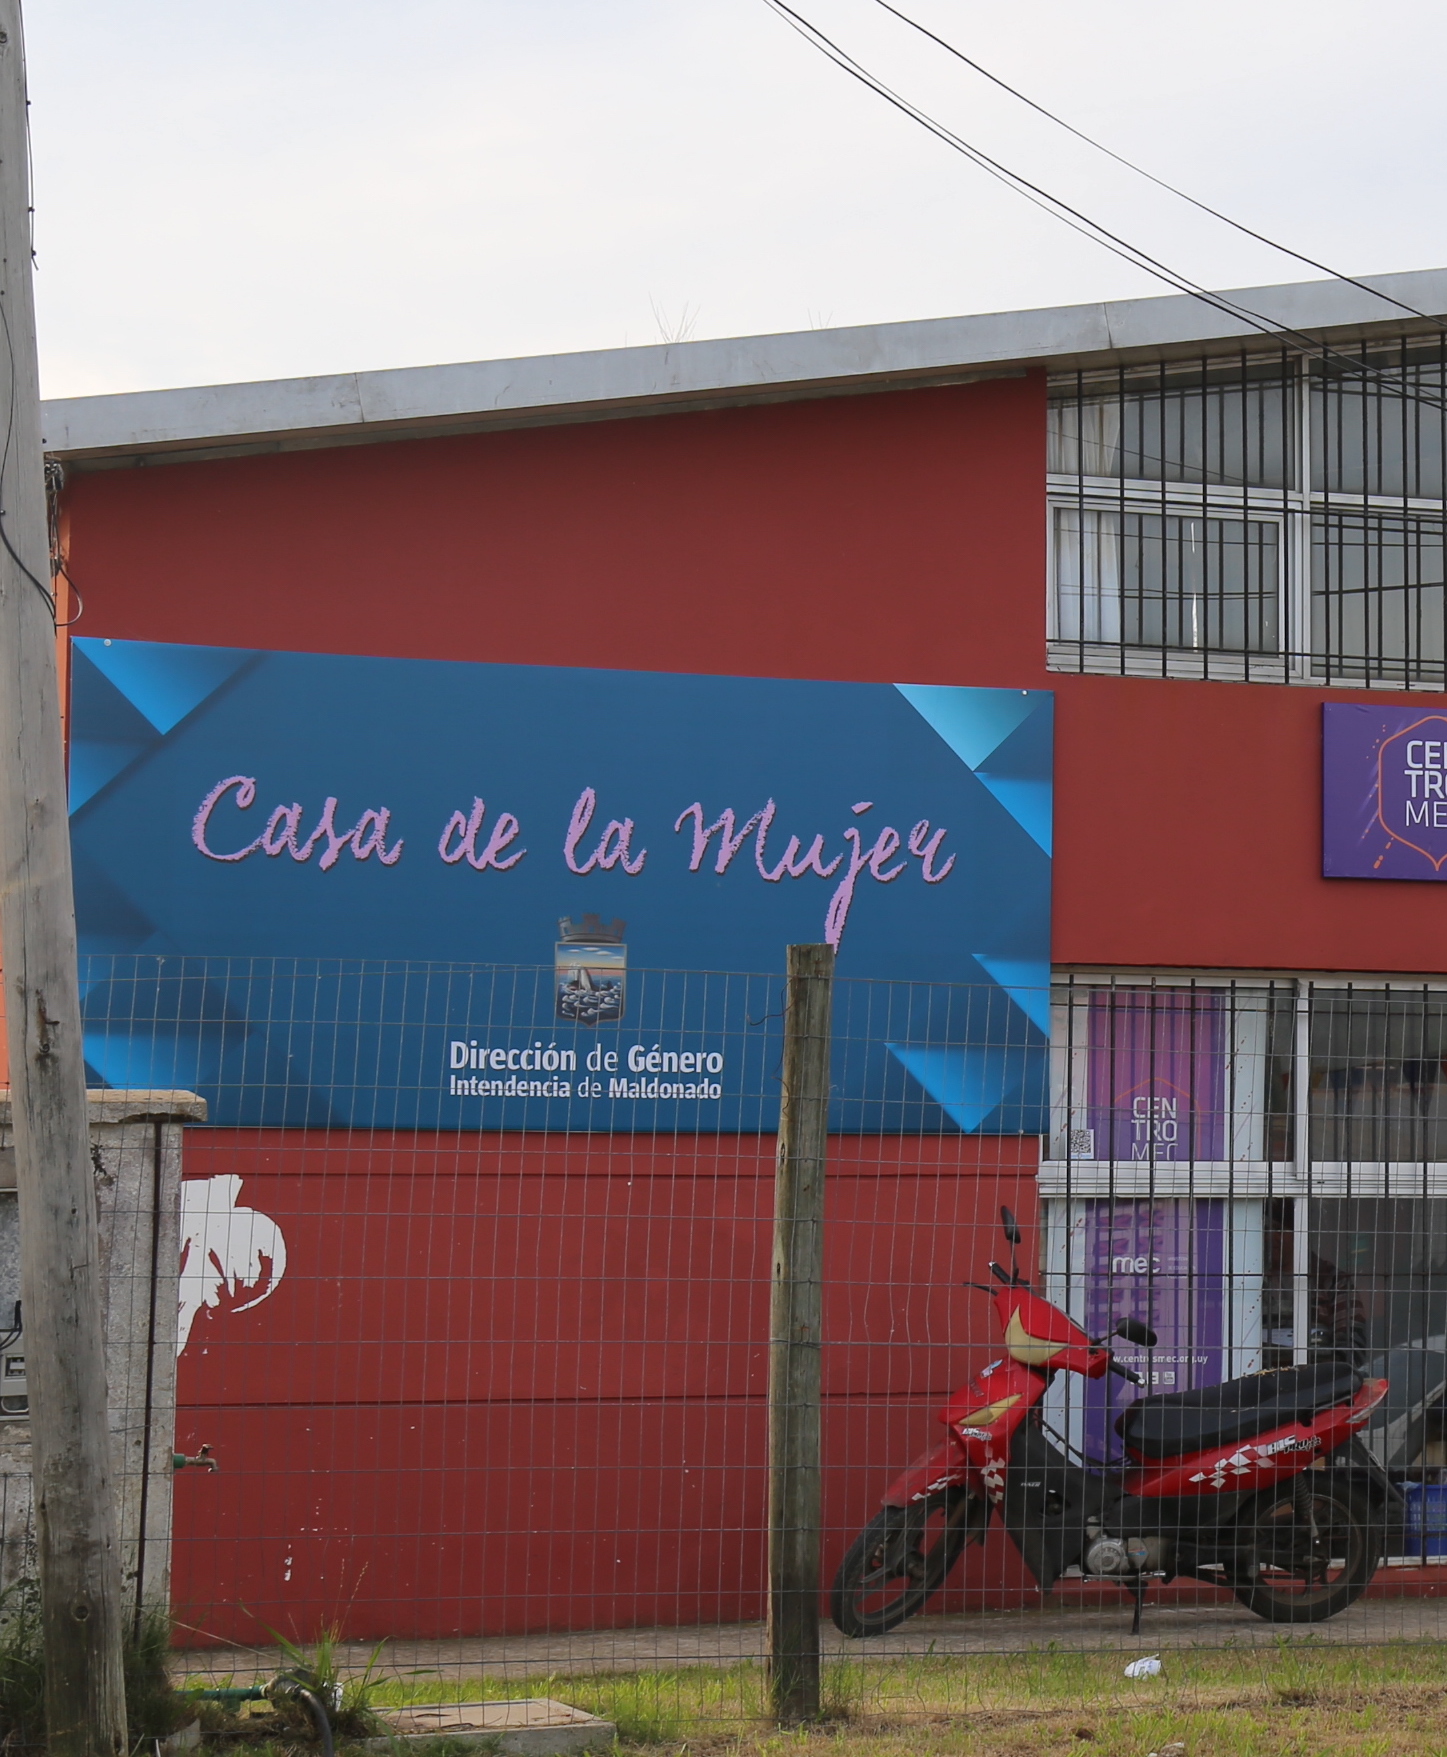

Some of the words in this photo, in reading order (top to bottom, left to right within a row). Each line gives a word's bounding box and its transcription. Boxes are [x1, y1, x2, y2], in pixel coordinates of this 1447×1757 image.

[191, 774, 404, 871] Casa
[438, 796, 526, 870] de
[563, 786, 647, 876] la
[674, 797, 956, 955] Mujer
[450, 1040, 577, 1072] Dirección
[586, 1043, 619, 1072] de
[627, 1043, 724, 1074] Género
[450, 1074, 571, 1098] Intendencia
[577, 1076, 602, 1098] de
[608, 1077, 722, 1100] Maldonado
[1133, 1096, 1177, 1119] CEN
[1131, 1119, 1178, 1141] TRO
[1112, 1256, 1161, 1274] mec
